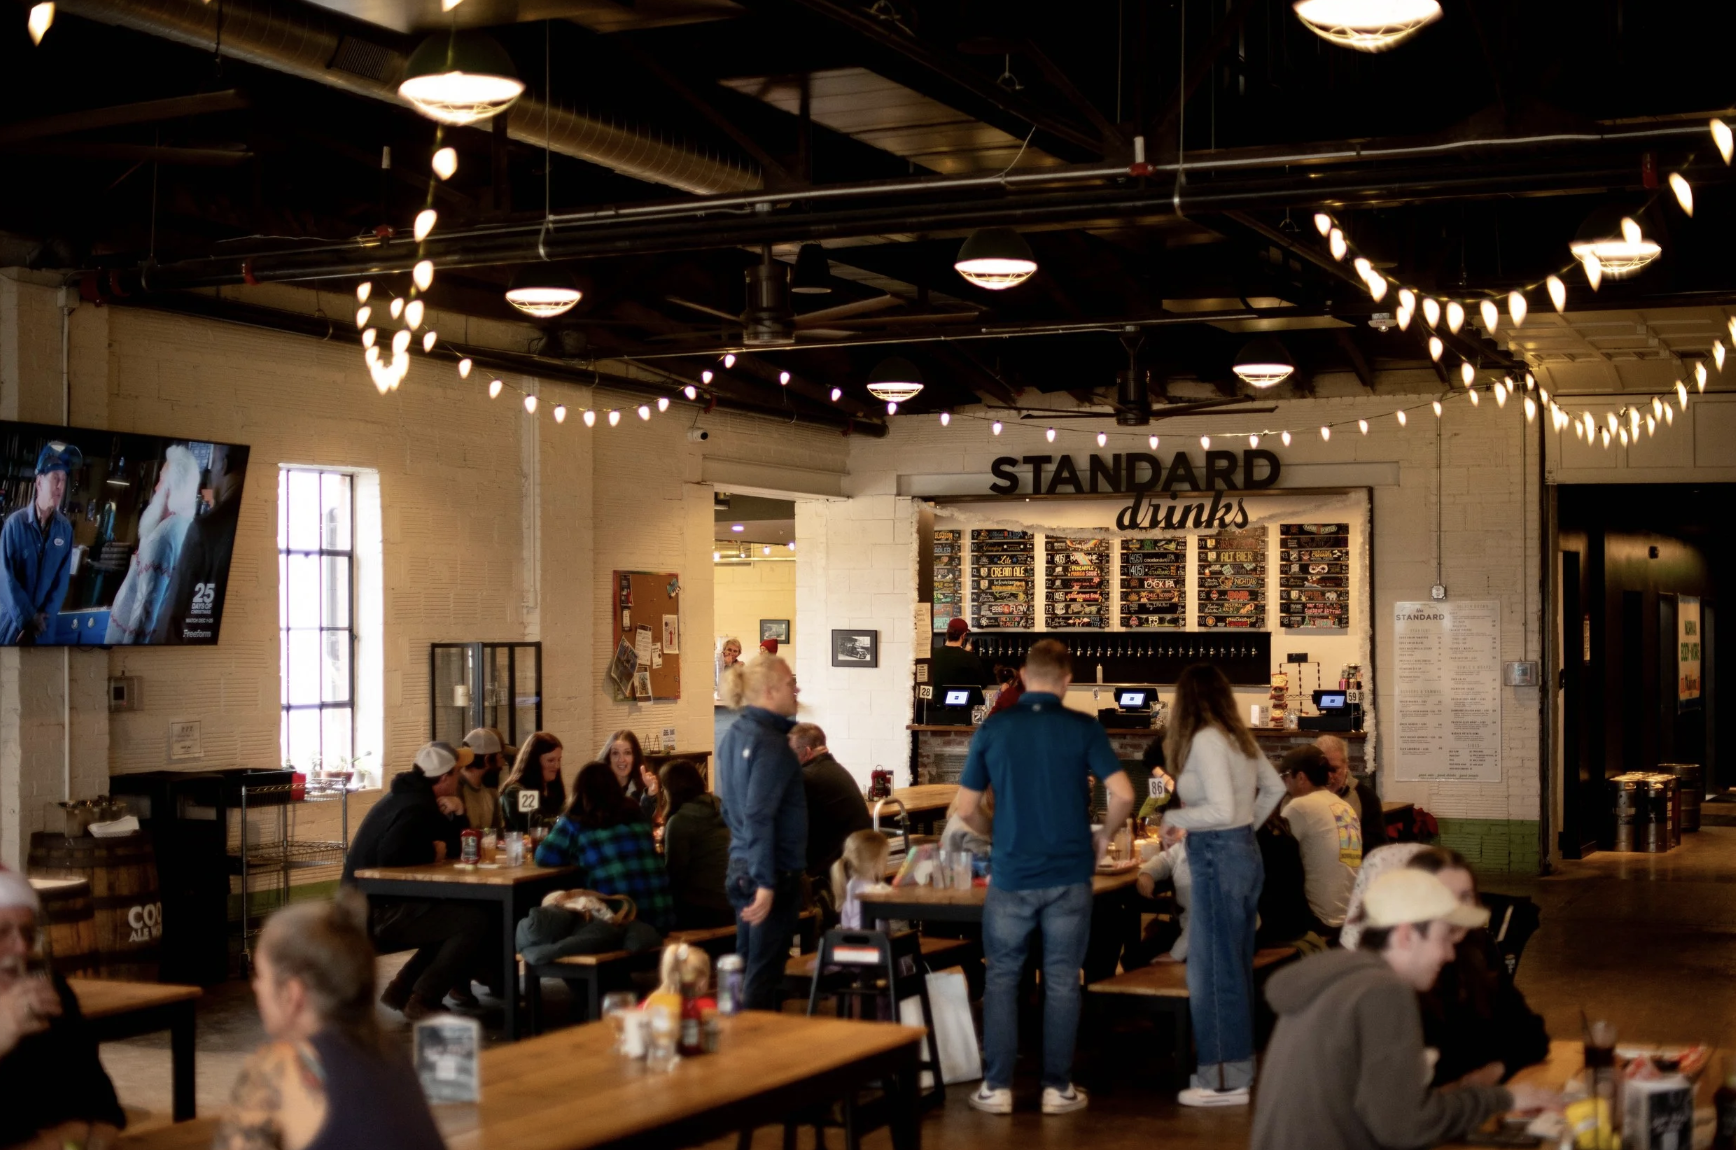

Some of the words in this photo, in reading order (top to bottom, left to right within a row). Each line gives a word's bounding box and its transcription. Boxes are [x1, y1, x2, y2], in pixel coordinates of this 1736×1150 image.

[989, 449, 1281, 494] STANDARD
[1115, 490, 1249, 531] drinks
[1220, 552, 1234, 562] ALT
[1236, 552, 1253, 562] BIER
[991, 566, 1013, 578] CREAM
[1013, 566, 1025, 577] ALE
[192, 582, 216, 603] 25
[1395, 613, 1445, 621] STANDARD
[182, 629, 212, 638] Freeform
[921, 687, 932, 697] 28
[1349, 692, 1357, 702] 59
[1151, 781, 1163, 795] 86
[521, 794, 536, 808] 22
[128, 927, 149, 943] ALE
